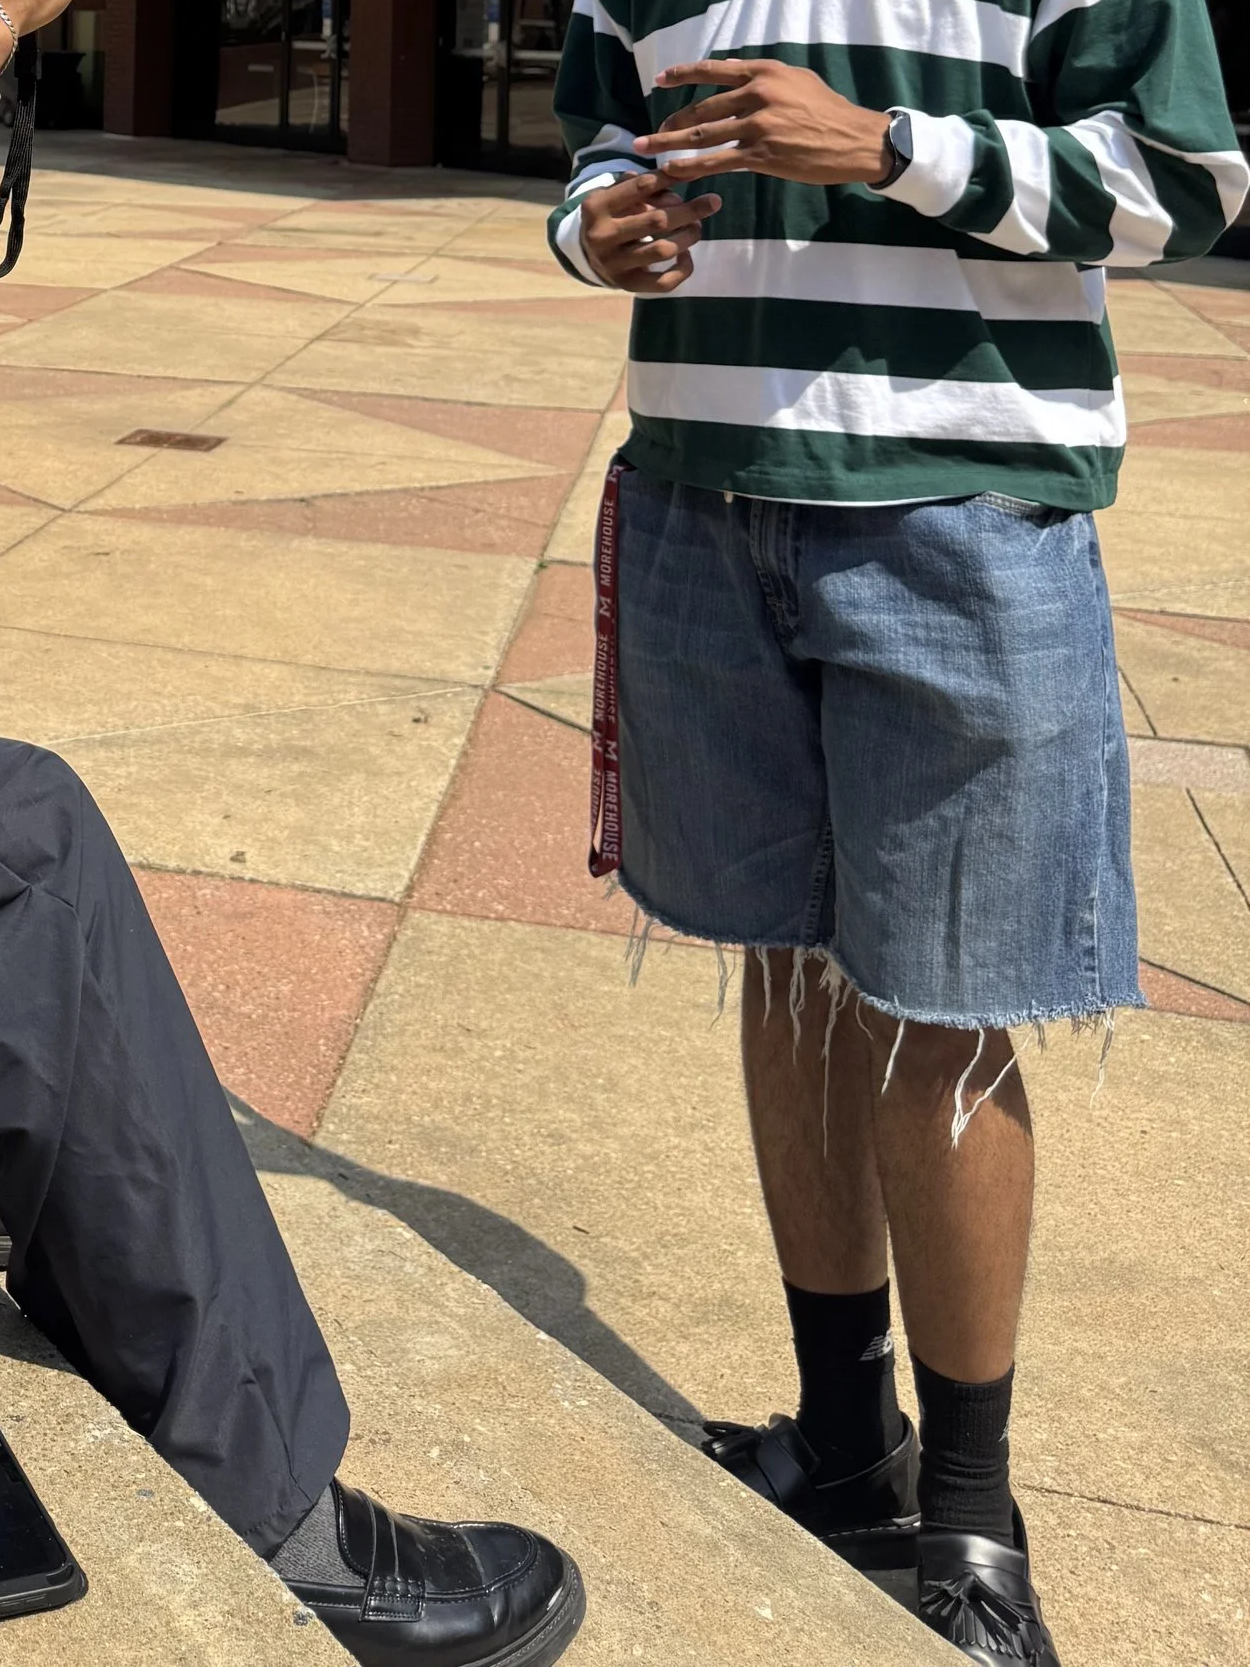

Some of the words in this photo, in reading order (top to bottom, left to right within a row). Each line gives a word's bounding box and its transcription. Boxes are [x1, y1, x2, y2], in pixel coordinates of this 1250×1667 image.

[600, 498, 615, 587] MOREHOUSE
[599, 596, 612, 618] M
[595, 632, 609, 722] MOREHOUSE
[605, 740, 618, 762] M
[602, 769, 618, 861] MOREHOUSE
